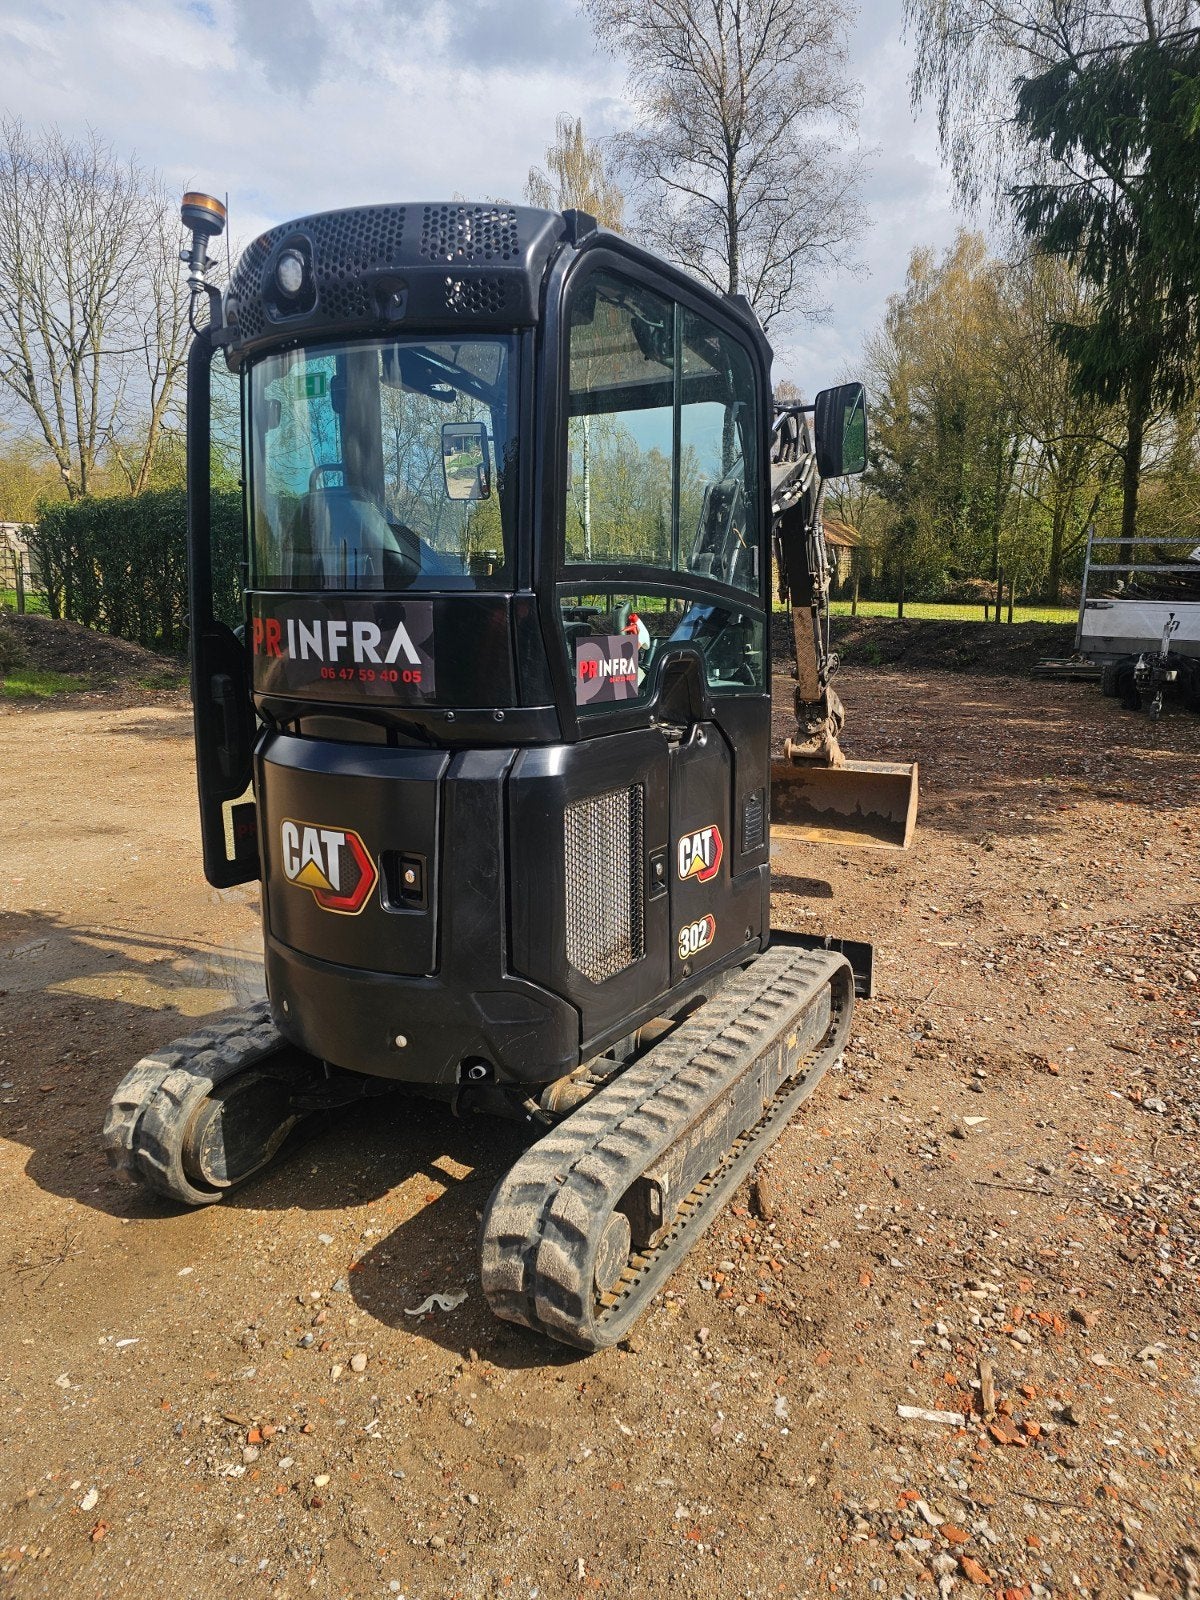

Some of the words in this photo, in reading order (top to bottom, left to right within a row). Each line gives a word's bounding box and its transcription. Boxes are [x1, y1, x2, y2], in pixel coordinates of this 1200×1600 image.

[320, 667, 336, 680] 06
[339, 668, 354, 681] 47
[358, 669, 376, 682] 59
[379, 670, 398, 683] 40
[402, 670, 422, 683] 05
[282, 821, 345, 892] CAT
[679, 828, 713, 878] CAT
[680, 919, 708, 955] 302
